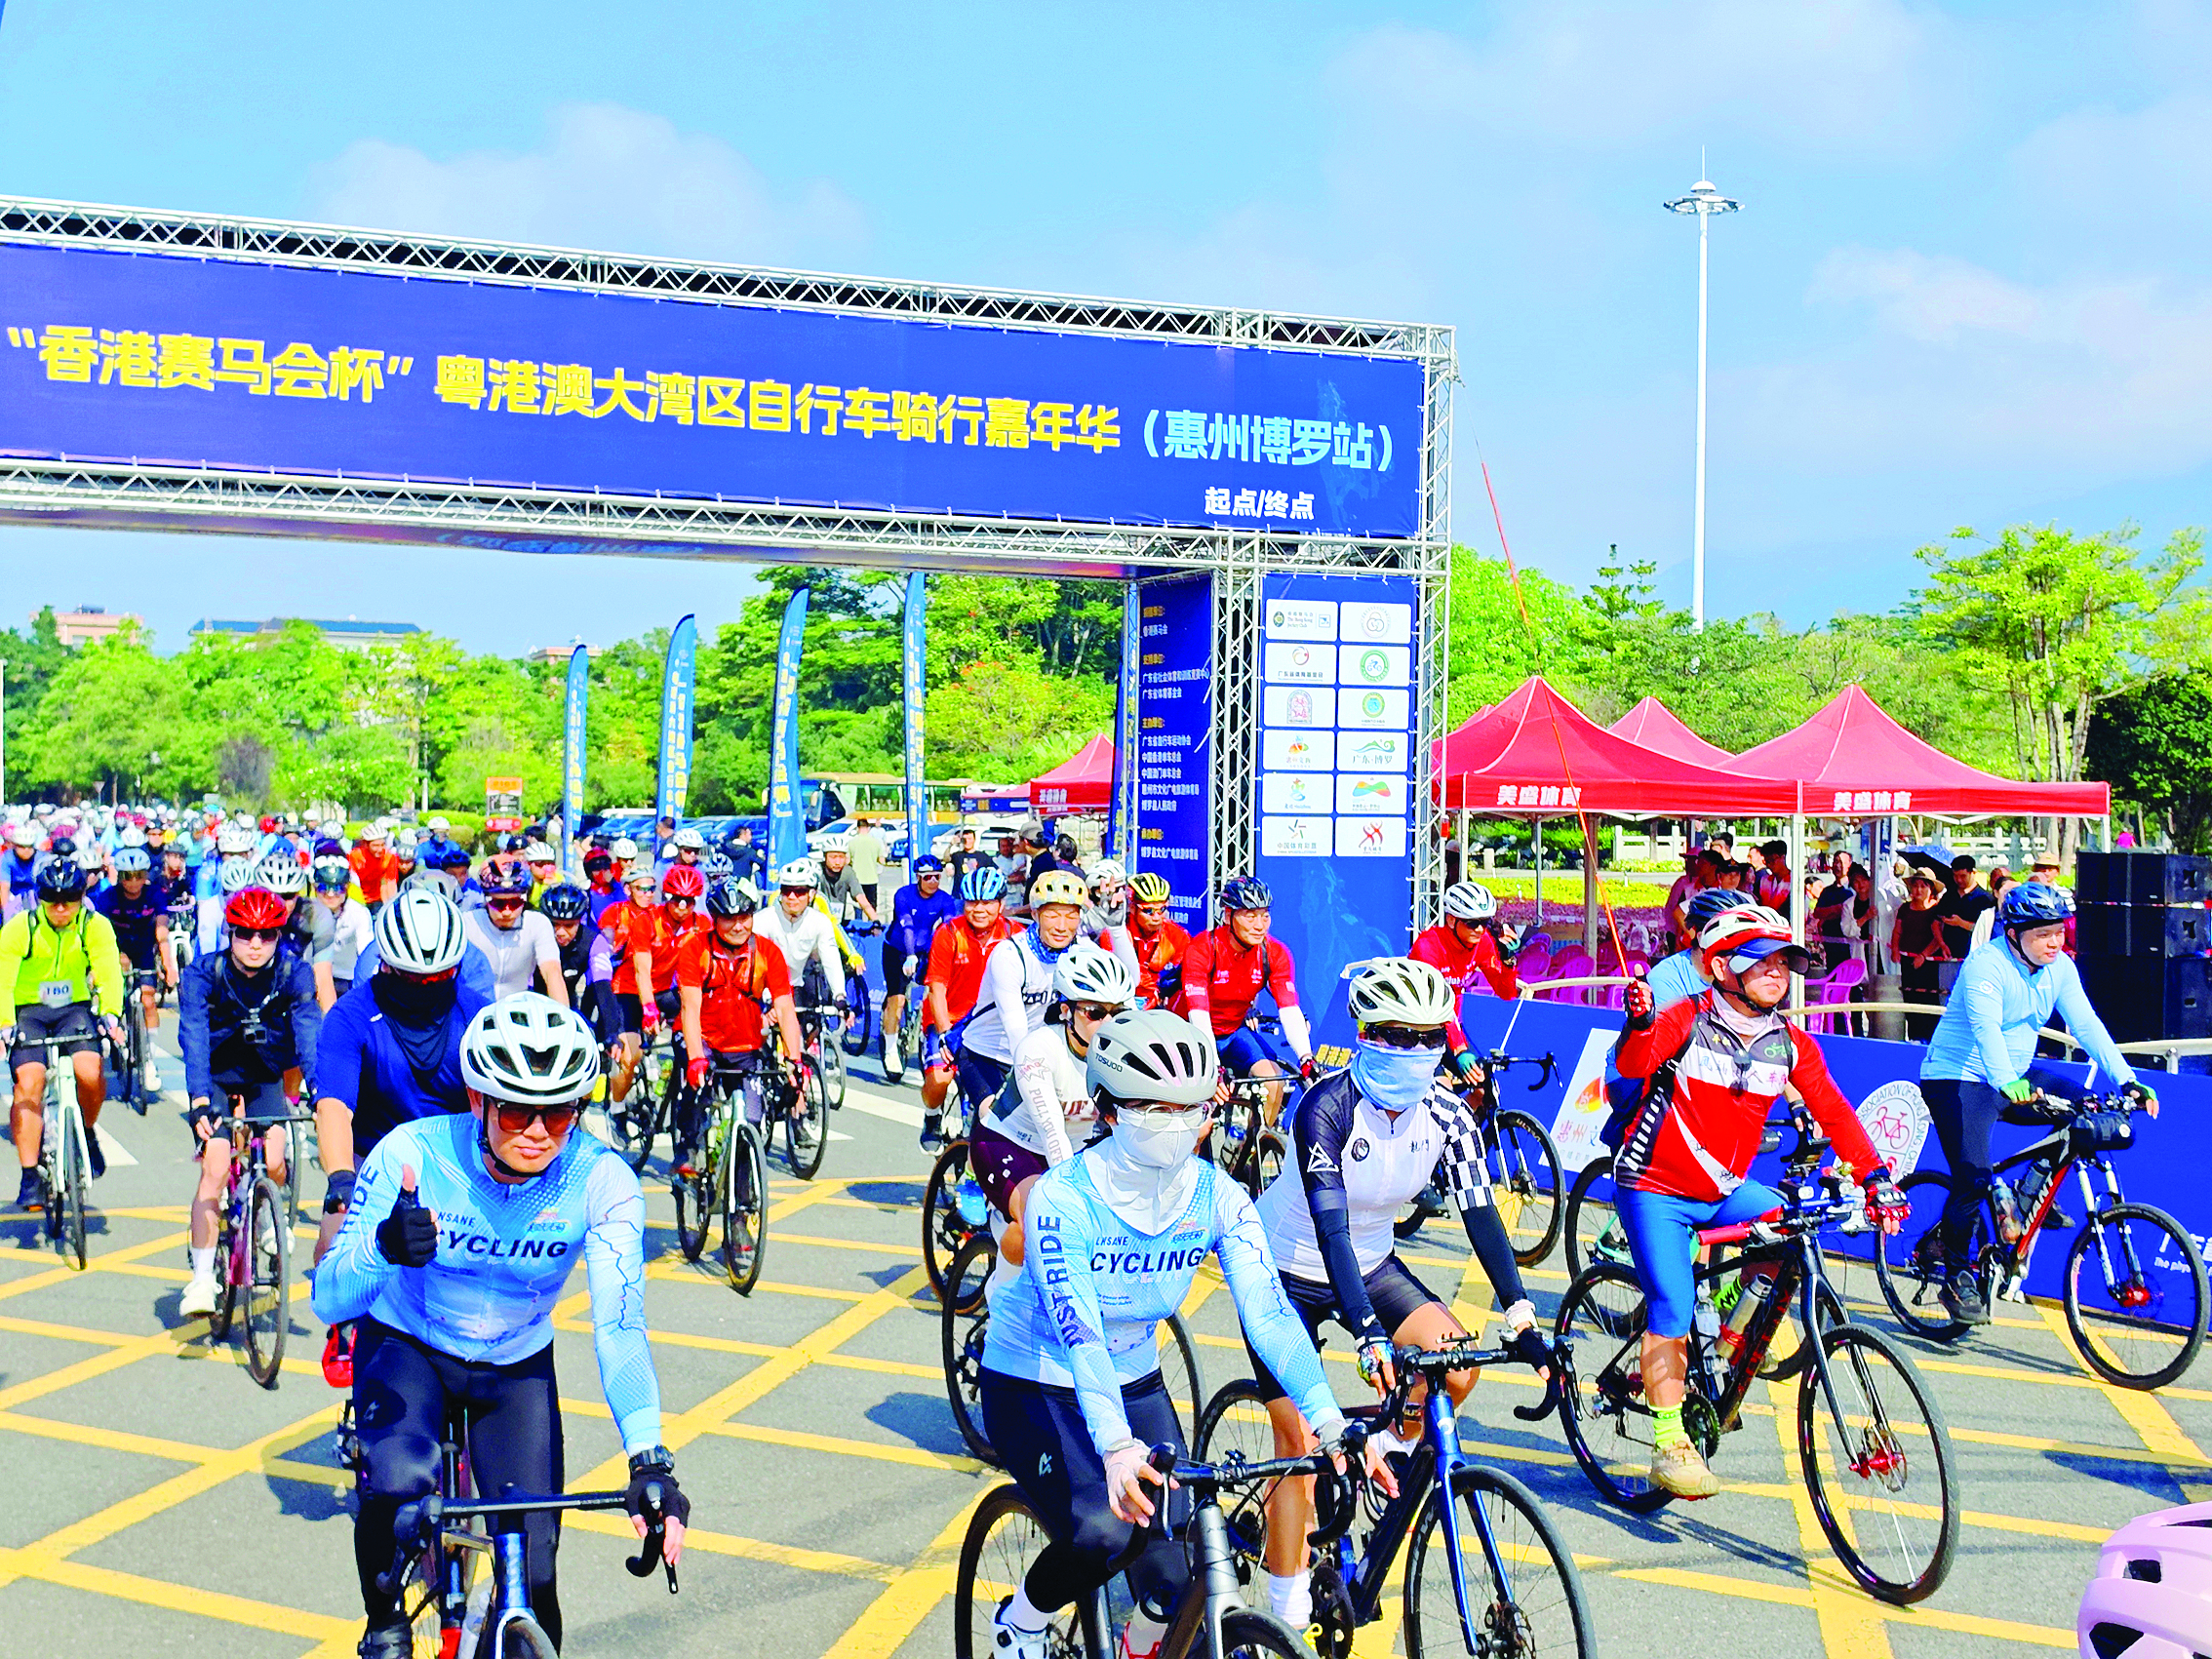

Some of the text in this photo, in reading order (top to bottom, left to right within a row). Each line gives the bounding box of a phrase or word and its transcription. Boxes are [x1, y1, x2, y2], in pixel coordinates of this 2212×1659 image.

[434, 353, 1122, 454] 粤港澳大湾区自行车骑行嘉年华
[1204, 487, 1316, 522] 起点/终点
[1497, 783, 1582, 807] 美盛体育
[1833, 791, 1913, 811] 美盛体育
[437, 1211, 477, 1228] NSANE
[439, 1230, 569, 1258] YCLING
[1037, 1215, 1069, 1285] RIDE
[1090, 1246, 1205, 1274] CYCLING
